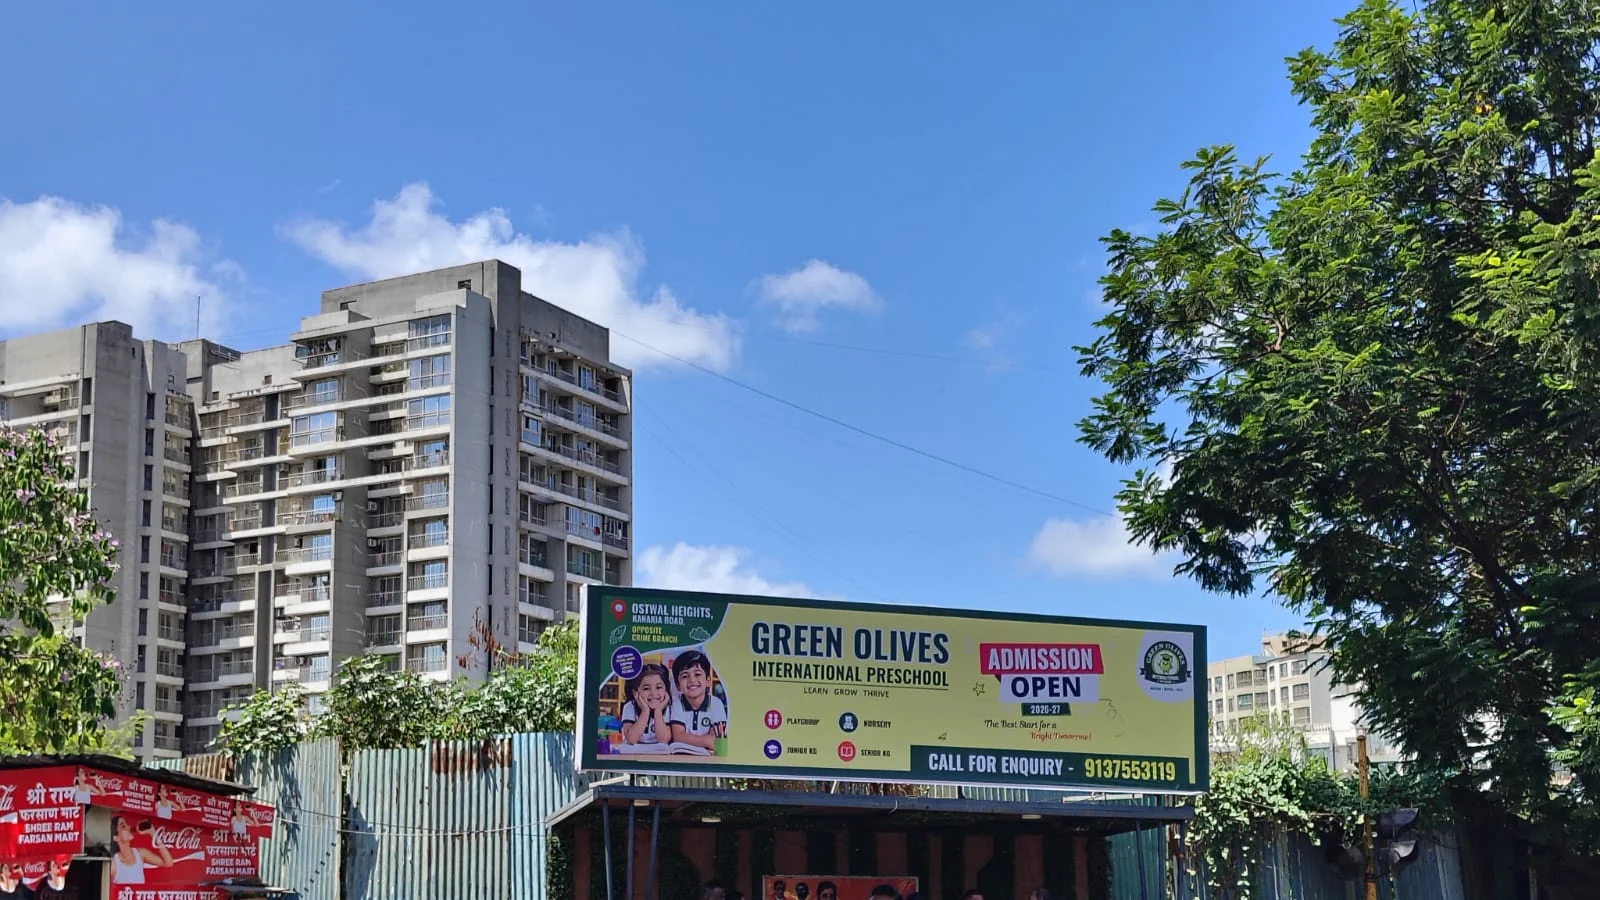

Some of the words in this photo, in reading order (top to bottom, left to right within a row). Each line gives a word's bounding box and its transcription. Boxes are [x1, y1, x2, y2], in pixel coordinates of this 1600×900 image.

[632, 604, 669, 616] OSTWAL
[671, 606, 714, 620] HEIGHTS,
[632, 626, 662, 634] OPPOSITE
[751, 621, 843, 658] GREEN
[854, 628, 950, 664] OLIVES
[988, 647, 1093, 671] ADMISSION
[752, 661, 862, 682] INTERNATIONAL
[867, 667, 950, 687] PRESCHOOL
[803, 687, 828, 695] LEARN
[834, 688, 858, 697] GROW
[863, 690, 889, 698] THRIVE
[1011, 676, 1082, 698] OPEN
[1030, 704, 1061, 715] 2026-27
[787, 718, 820, 726] PLAYGROUP
[863, 720, 891, 729] NURSERY
[984, 720, 999, 729] The
[1019, 720, 1038, 729] Start
[1039, 720, 1051, 731] for
[928, 753, 964, 772] CALL
[968, 754, 997, 773] FOR
[1001, 756, 1063, 776] ENQUIRY
[1084, 758, 1176, 781] 9137553119
[27, 783, 46, 805] श्री
[25, 824, 52, 834] SHREE
[54, 822, 73, 831] RAM
[18, 834, 52, 844] FARSAN
[54, 832, 80, 843] MART
[152, 827, 203, 849] Coca-Cola
